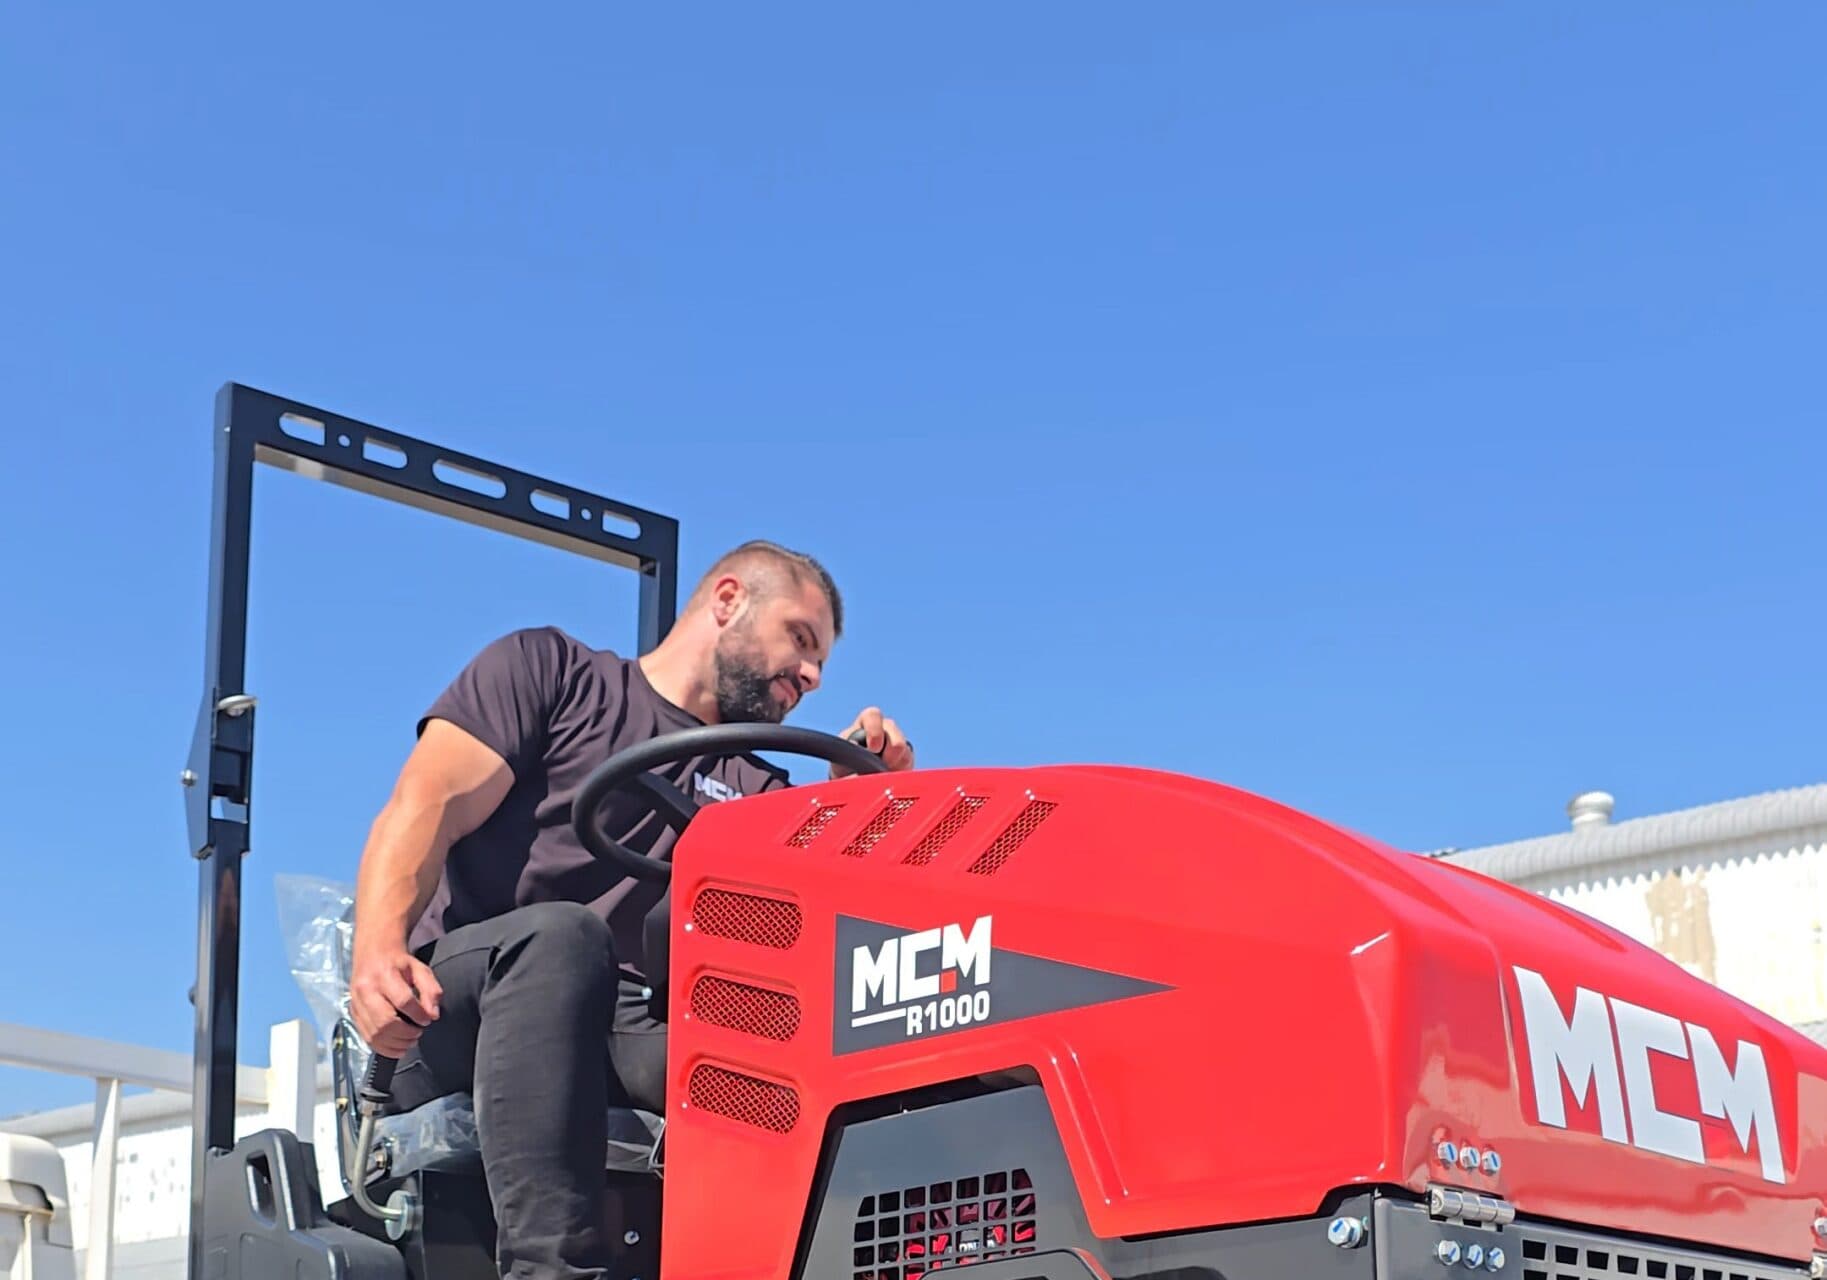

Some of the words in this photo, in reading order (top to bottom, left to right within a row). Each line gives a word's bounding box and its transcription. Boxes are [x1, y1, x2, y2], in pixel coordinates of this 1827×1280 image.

[851, 914, 992, 1013] MCM
[906, 990, 990, 1035] R1000
[1512, 965, 1786, 1184] MCM
